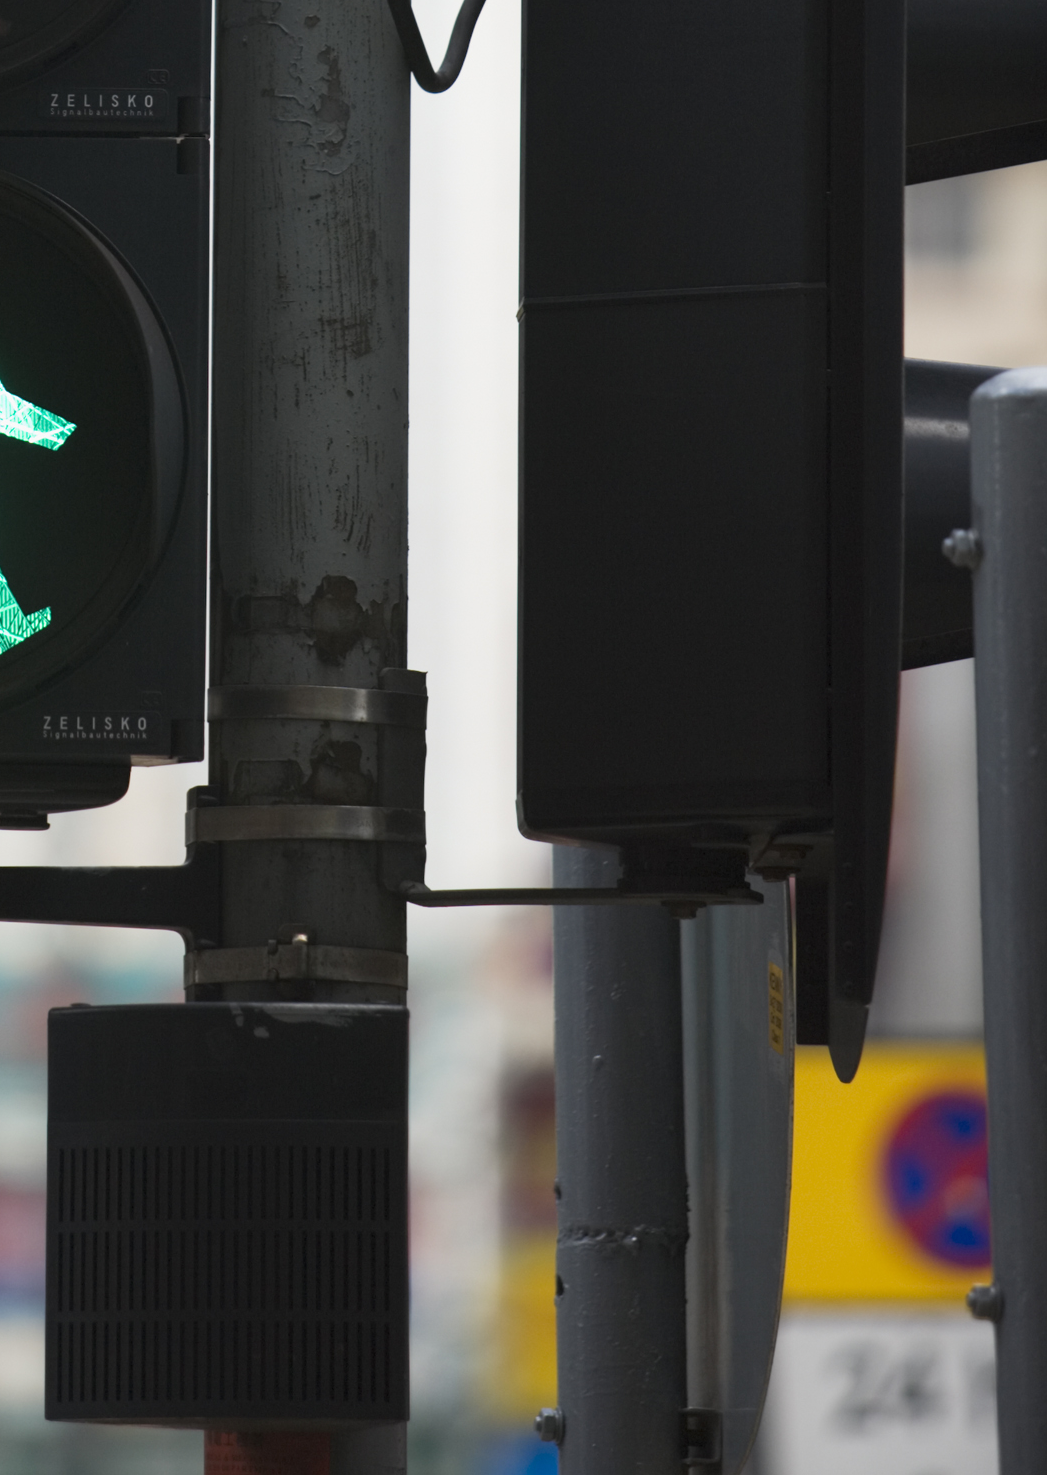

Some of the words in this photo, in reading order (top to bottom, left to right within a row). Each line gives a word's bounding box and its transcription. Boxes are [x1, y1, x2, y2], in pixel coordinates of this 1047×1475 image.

[50, 93, 154, 108] ZELISKO
[50, 108, 154, 117] Signalbautechnik
[43, 716, 147, 730] ZELISKO
[43, 731, 147, 739] Signalbautechnik
